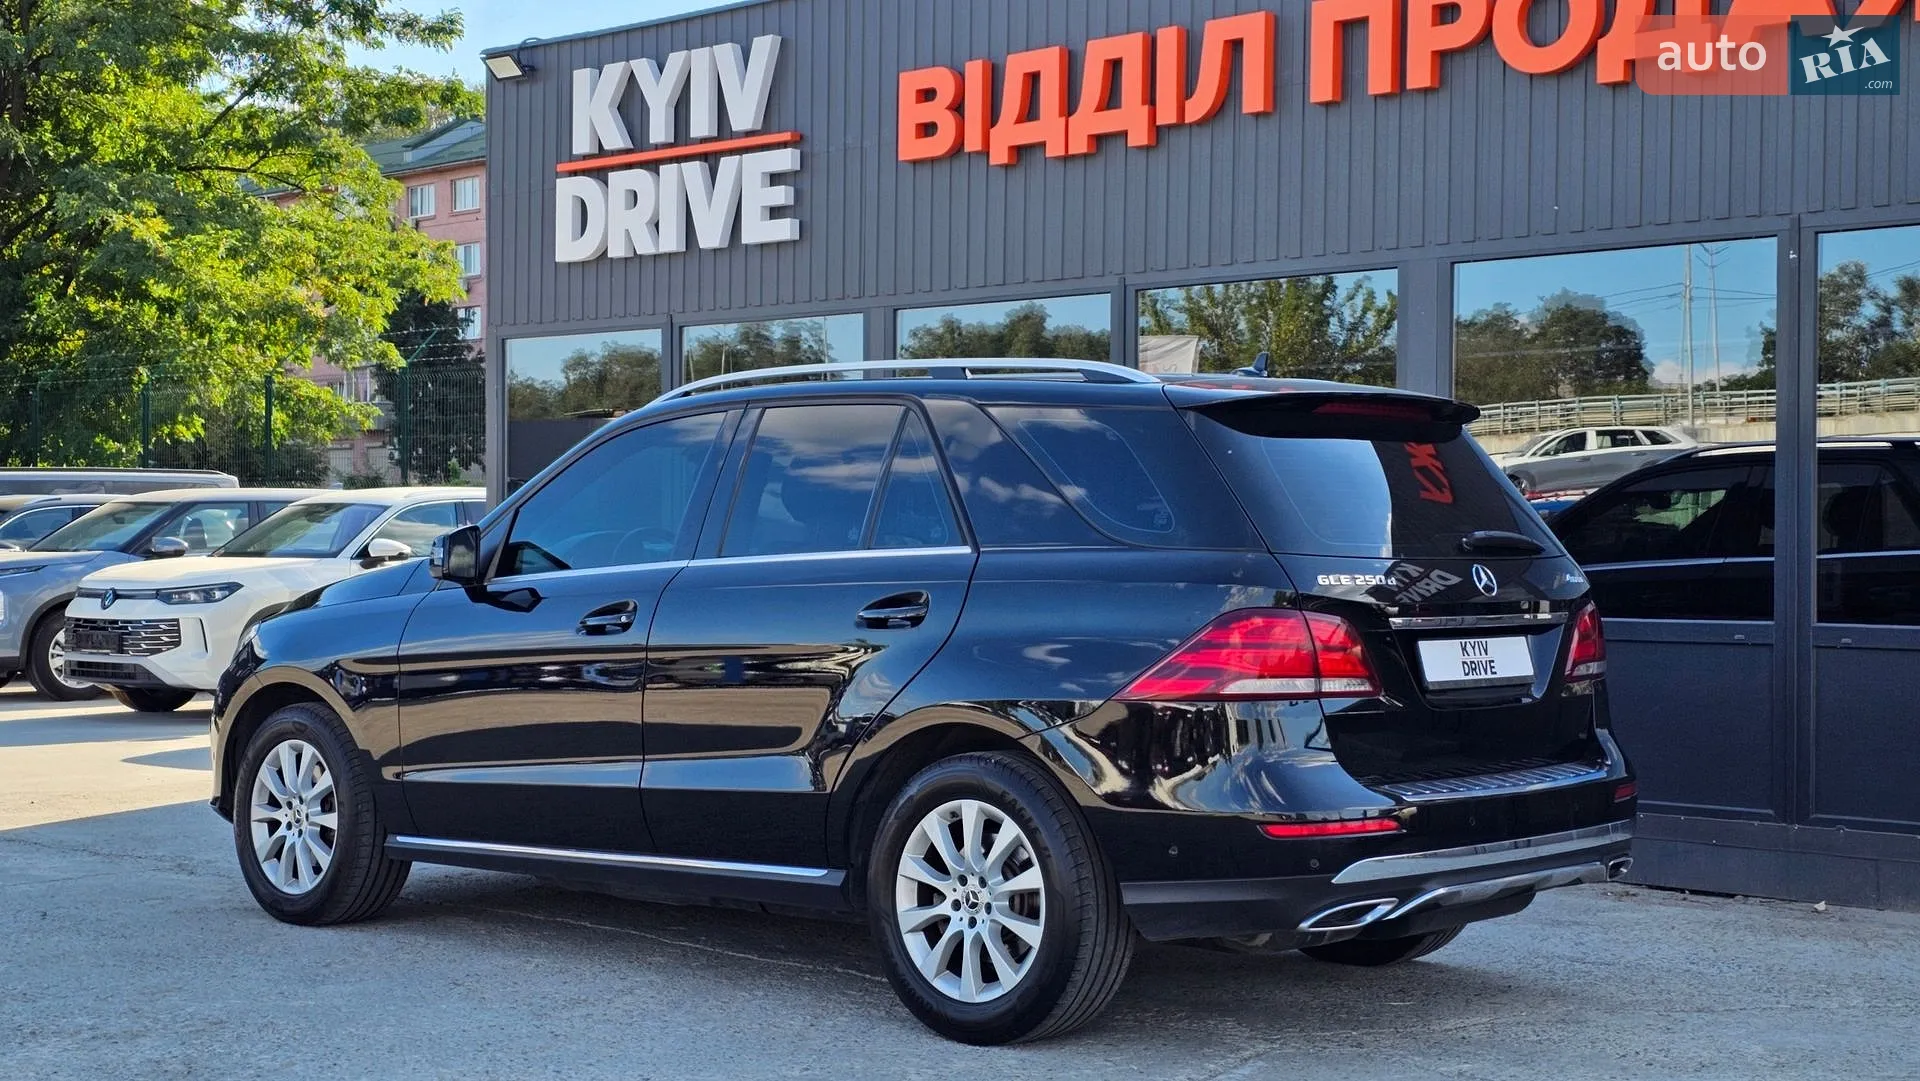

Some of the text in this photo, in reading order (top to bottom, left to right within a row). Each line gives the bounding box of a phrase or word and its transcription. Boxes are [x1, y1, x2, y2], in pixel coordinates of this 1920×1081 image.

[572, 34, 782, 155] KYIV
[898, 10, 1275, 166] ВІДДІЛ
[556, 148, 800, 263] DRIVE
[1317, 574, 1351, 586] GLE
[1352, 574, 1386, 586] 250
[1460, 640, 1489, 657] KYIV
[1462, 659, 1497, 676] DRIVE
